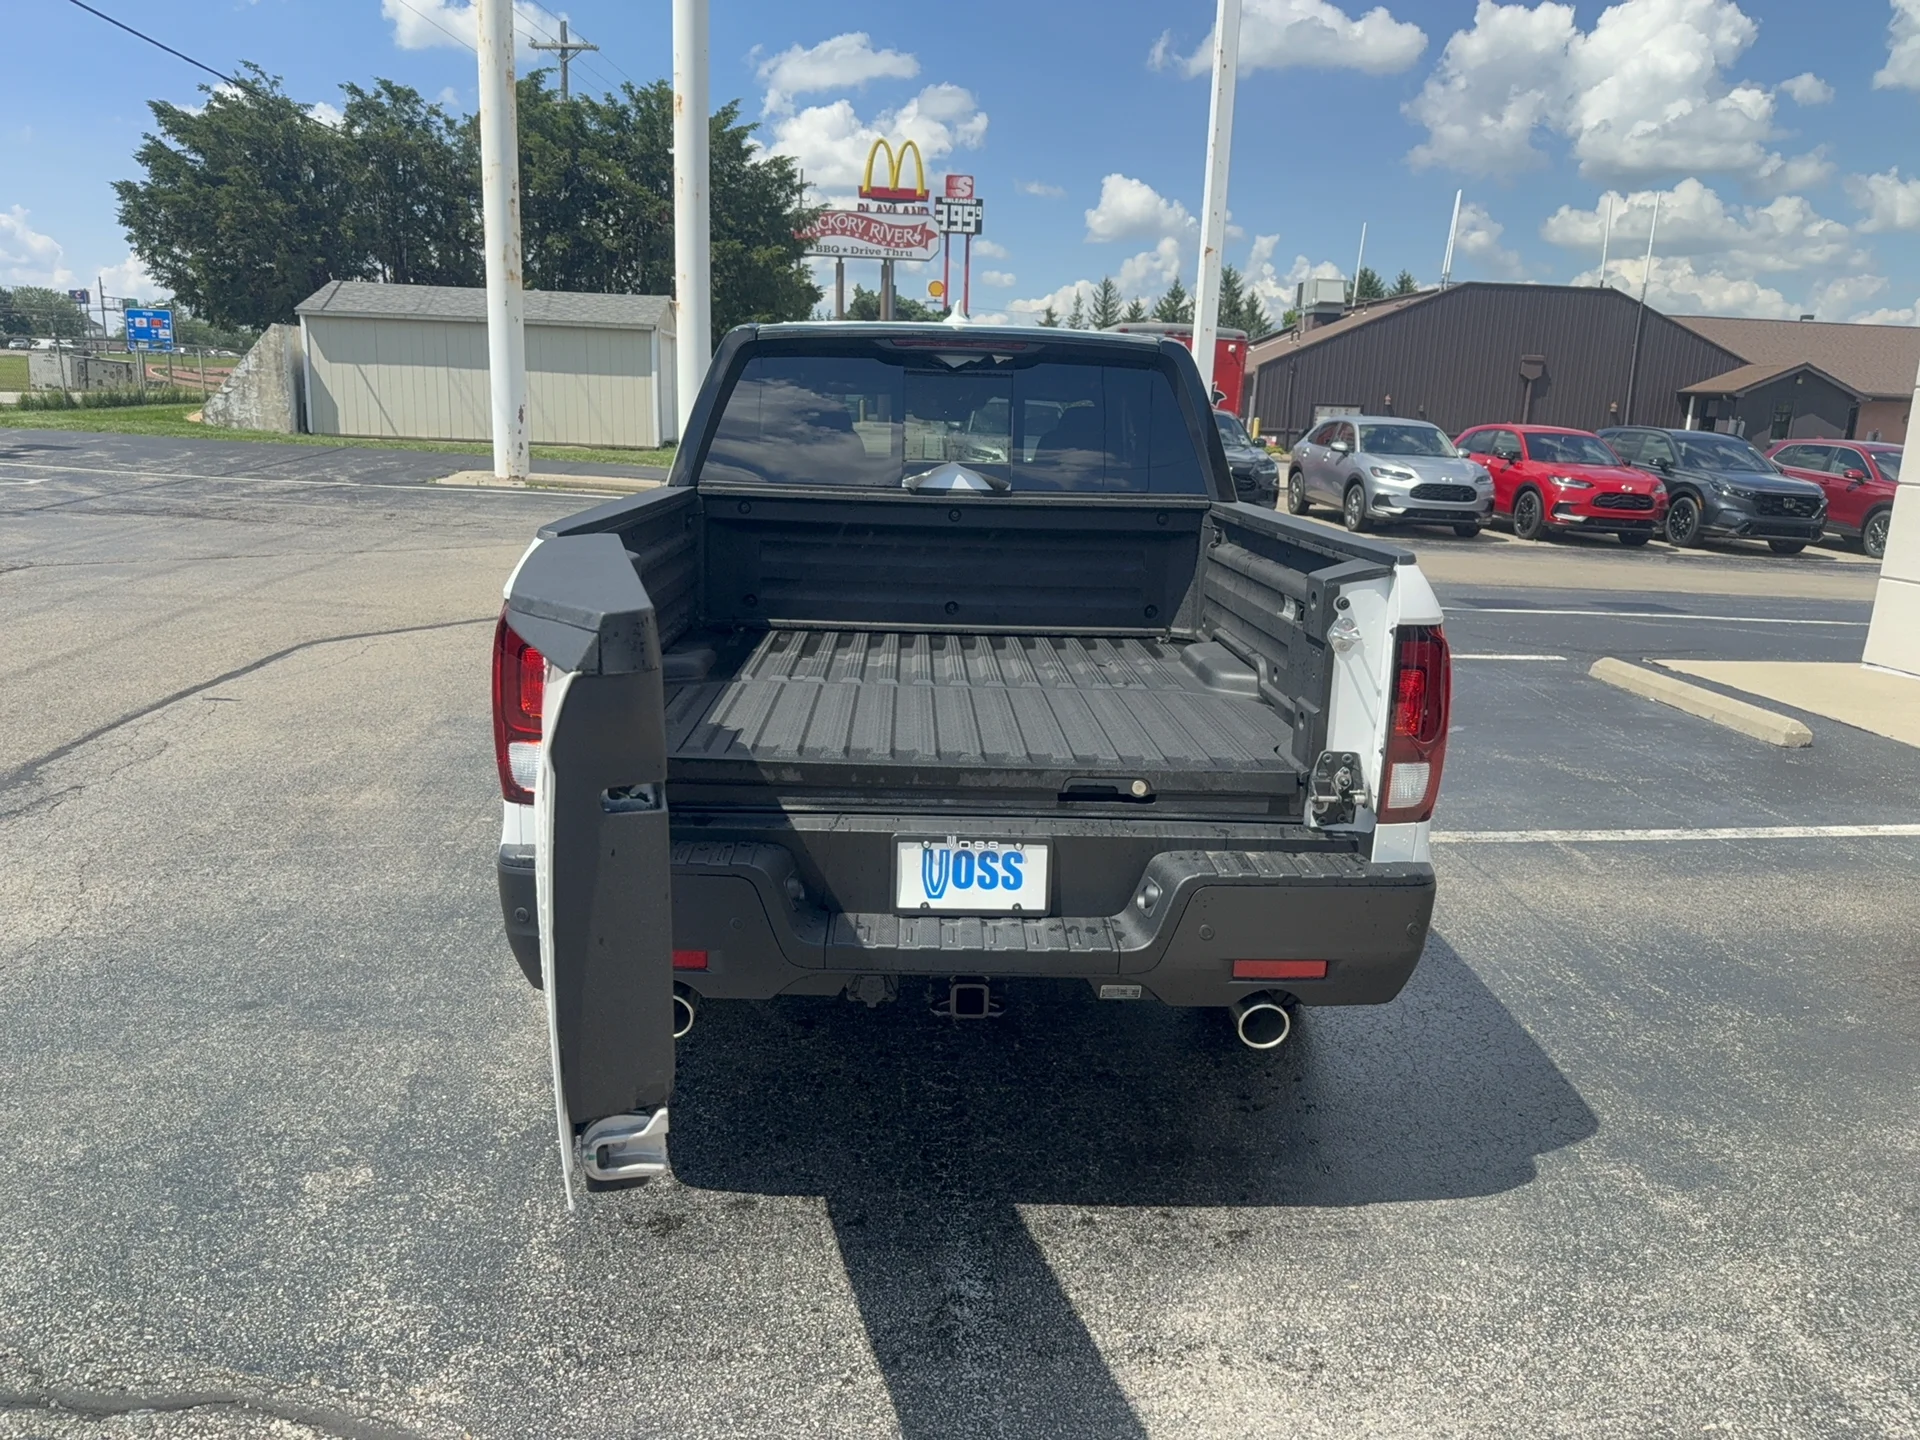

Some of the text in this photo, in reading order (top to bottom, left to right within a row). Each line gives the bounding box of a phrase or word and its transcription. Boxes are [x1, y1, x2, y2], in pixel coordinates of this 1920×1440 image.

[815, 244, 913, 257] BBQ Drive Thru
